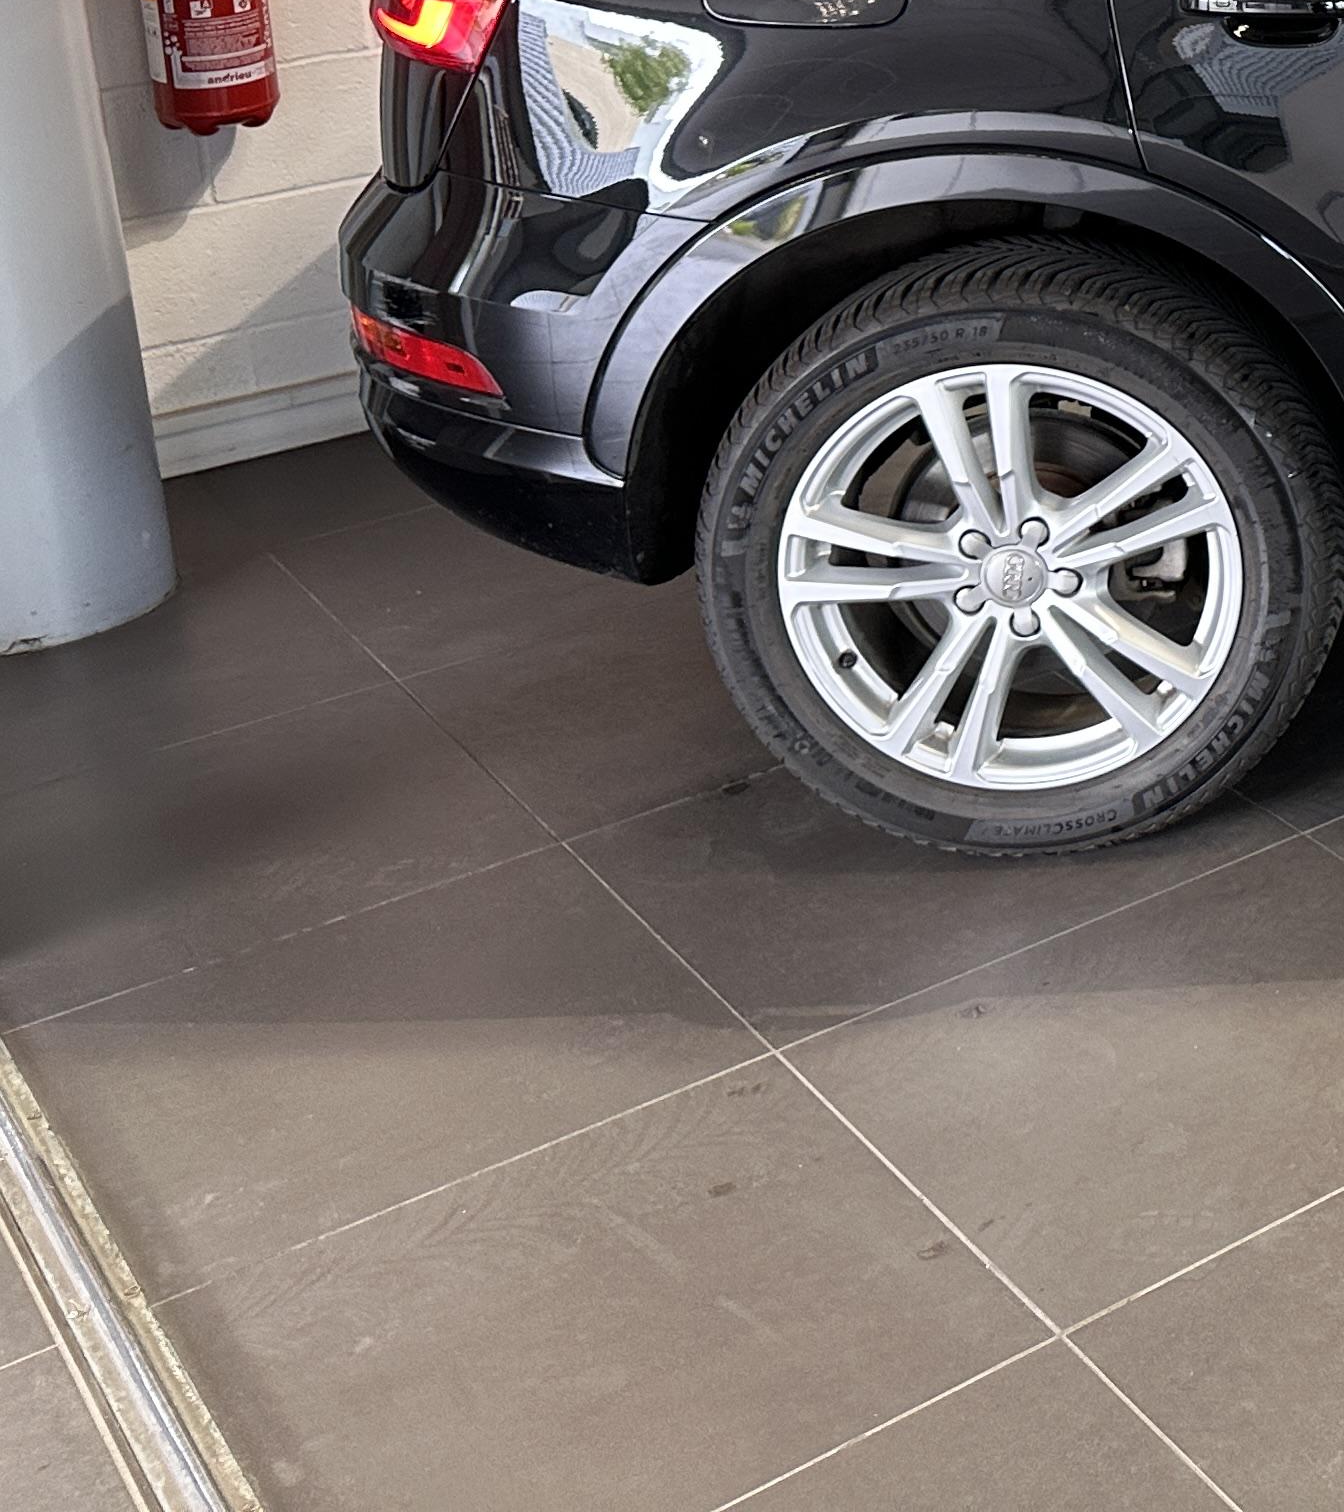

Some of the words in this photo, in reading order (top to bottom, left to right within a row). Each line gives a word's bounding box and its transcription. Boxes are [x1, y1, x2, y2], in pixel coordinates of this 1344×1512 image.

[207, 71, 252, 85] andrieu
[740, 351, 869, 496] MICHELIN
[1143, 671, 1272, 811] MICHELIN
[993, 808, 1118, 837] CROSSCLIMATE
